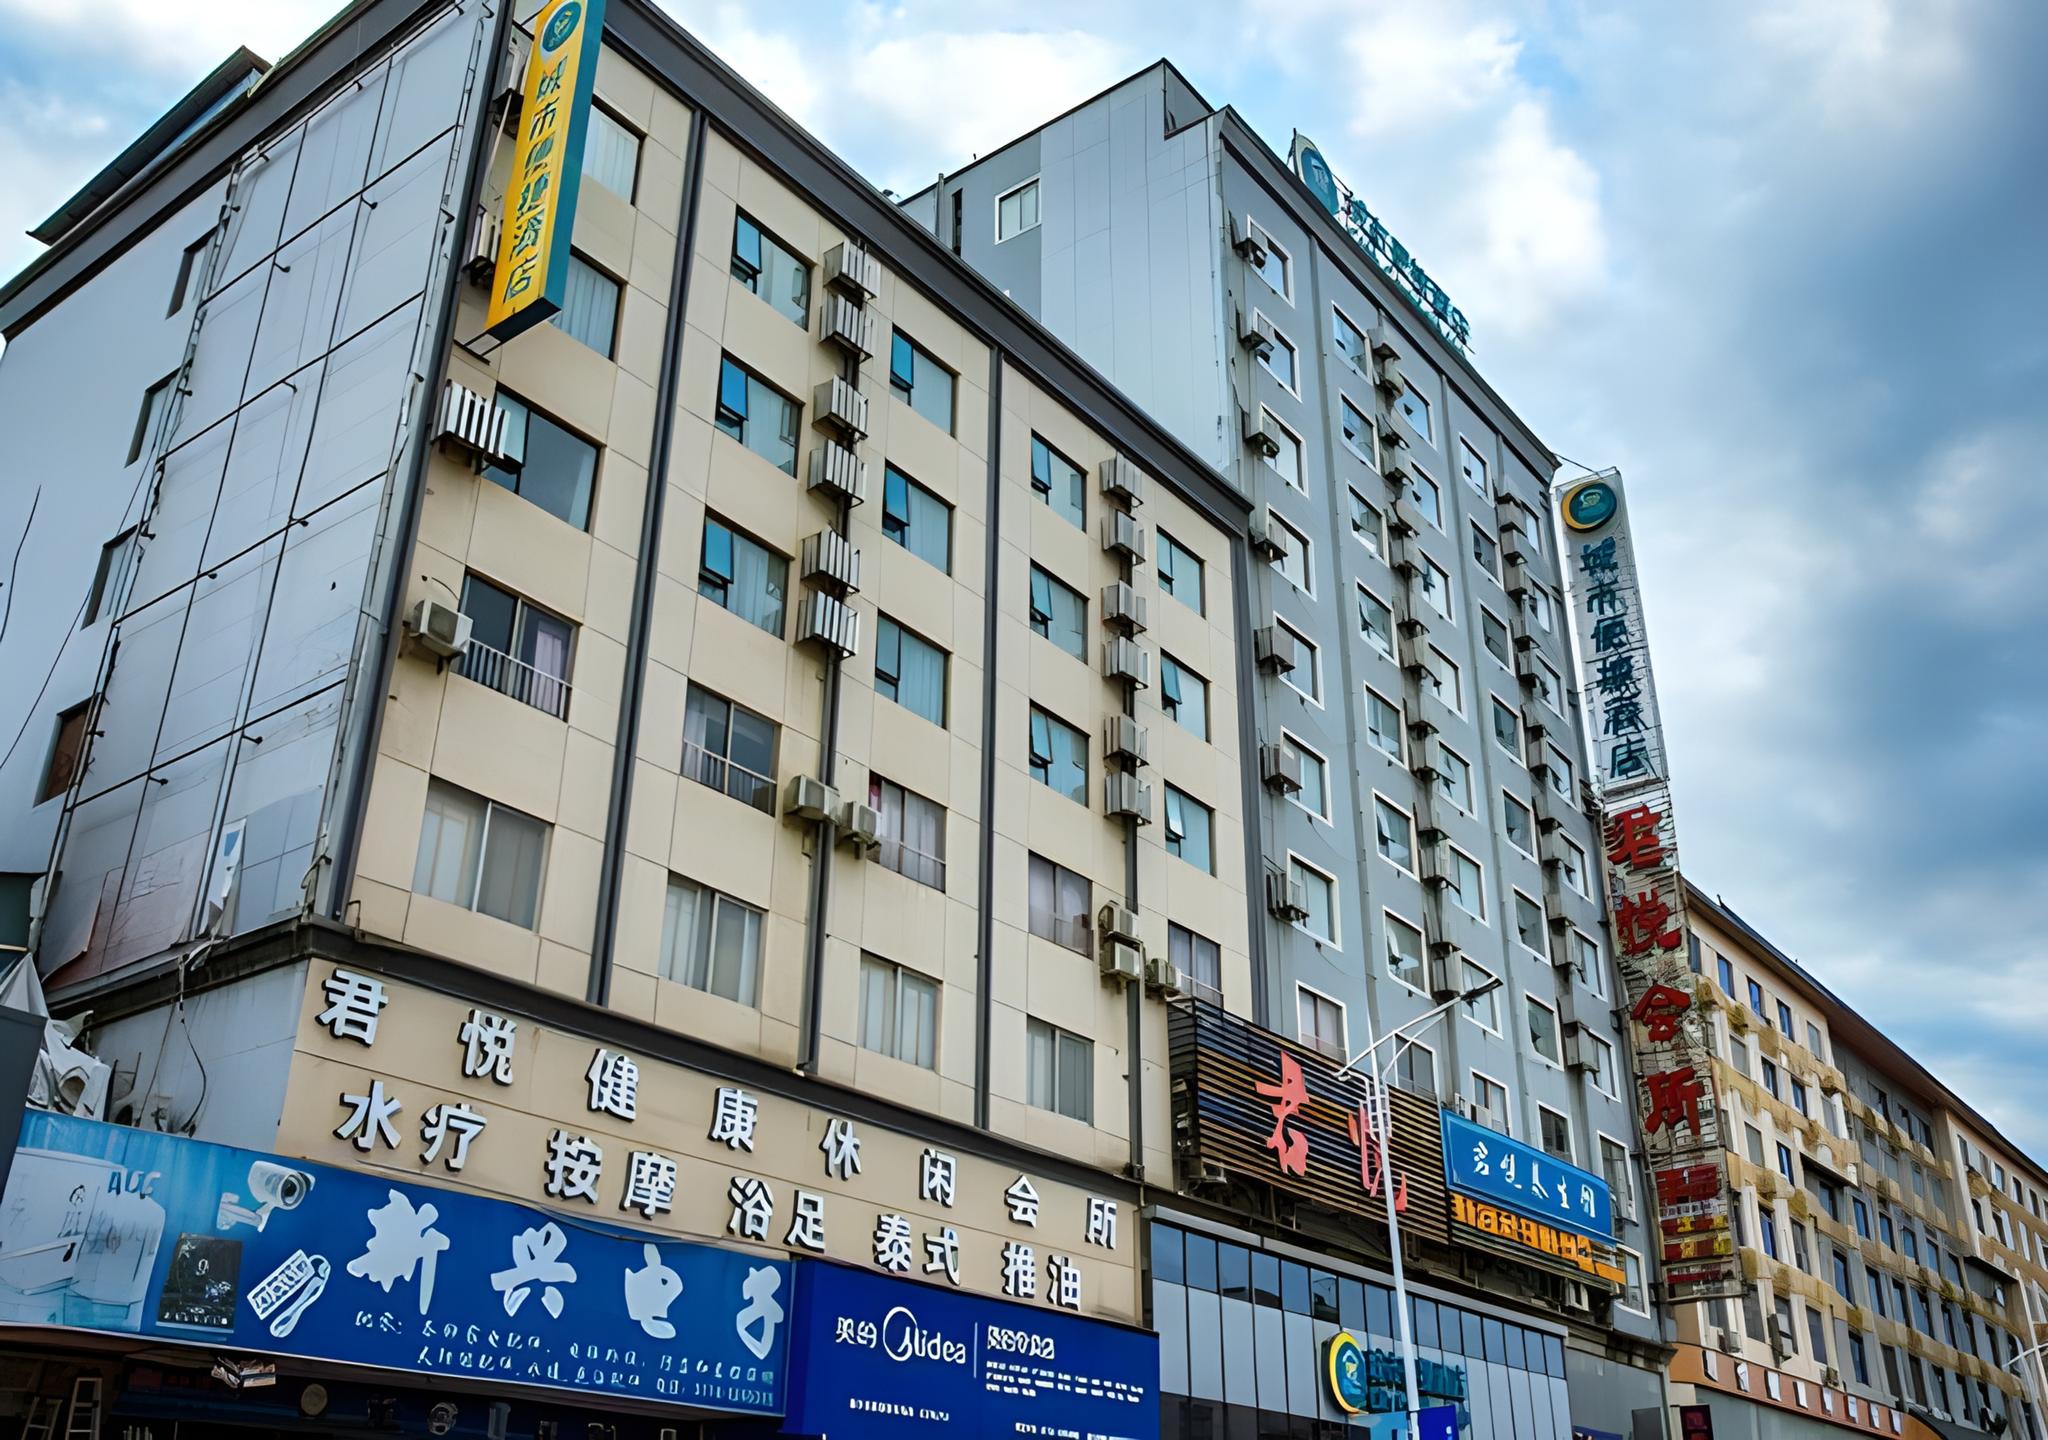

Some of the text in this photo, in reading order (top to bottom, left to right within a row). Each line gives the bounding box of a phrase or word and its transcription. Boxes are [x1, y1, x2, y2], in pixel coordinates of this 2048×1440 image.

[315, 967, 1118, 1249] 君悦健康休闲会所
[332, 1079, 1081, 1311] 水疗 按摩 浴足 泰式 推油
[346, 1188, 785, 1360] 新兴电子
